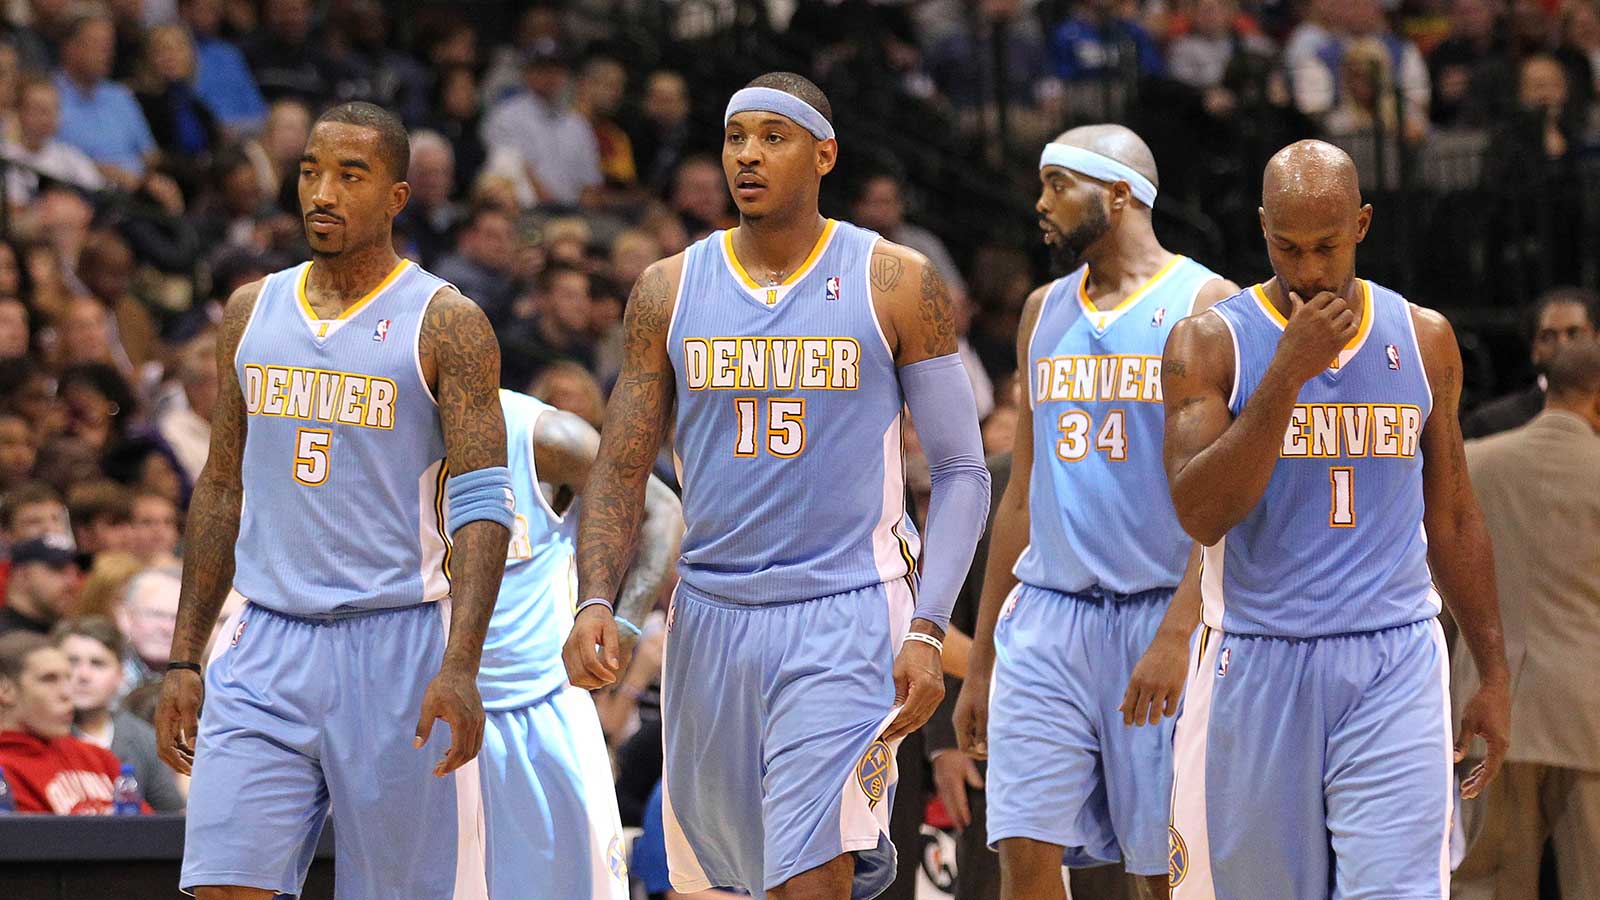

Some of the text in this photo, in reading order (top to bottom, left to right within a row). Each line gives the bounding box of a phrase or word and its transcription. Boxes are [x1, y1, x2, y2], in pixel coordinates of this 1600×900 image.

[684, 336, 861, 391] DENVER
[1036, 354, 1164, 405] DENVER
[244, 363, 398, 430] DENVER
[292, 427, 334, 487] 5
[734, 397, 806, 459] 15
[1056, 409, 1128, 463] 34
[1279, 403, 1423, 459] ENVER
[1329, 466, 1356, 528] 1
